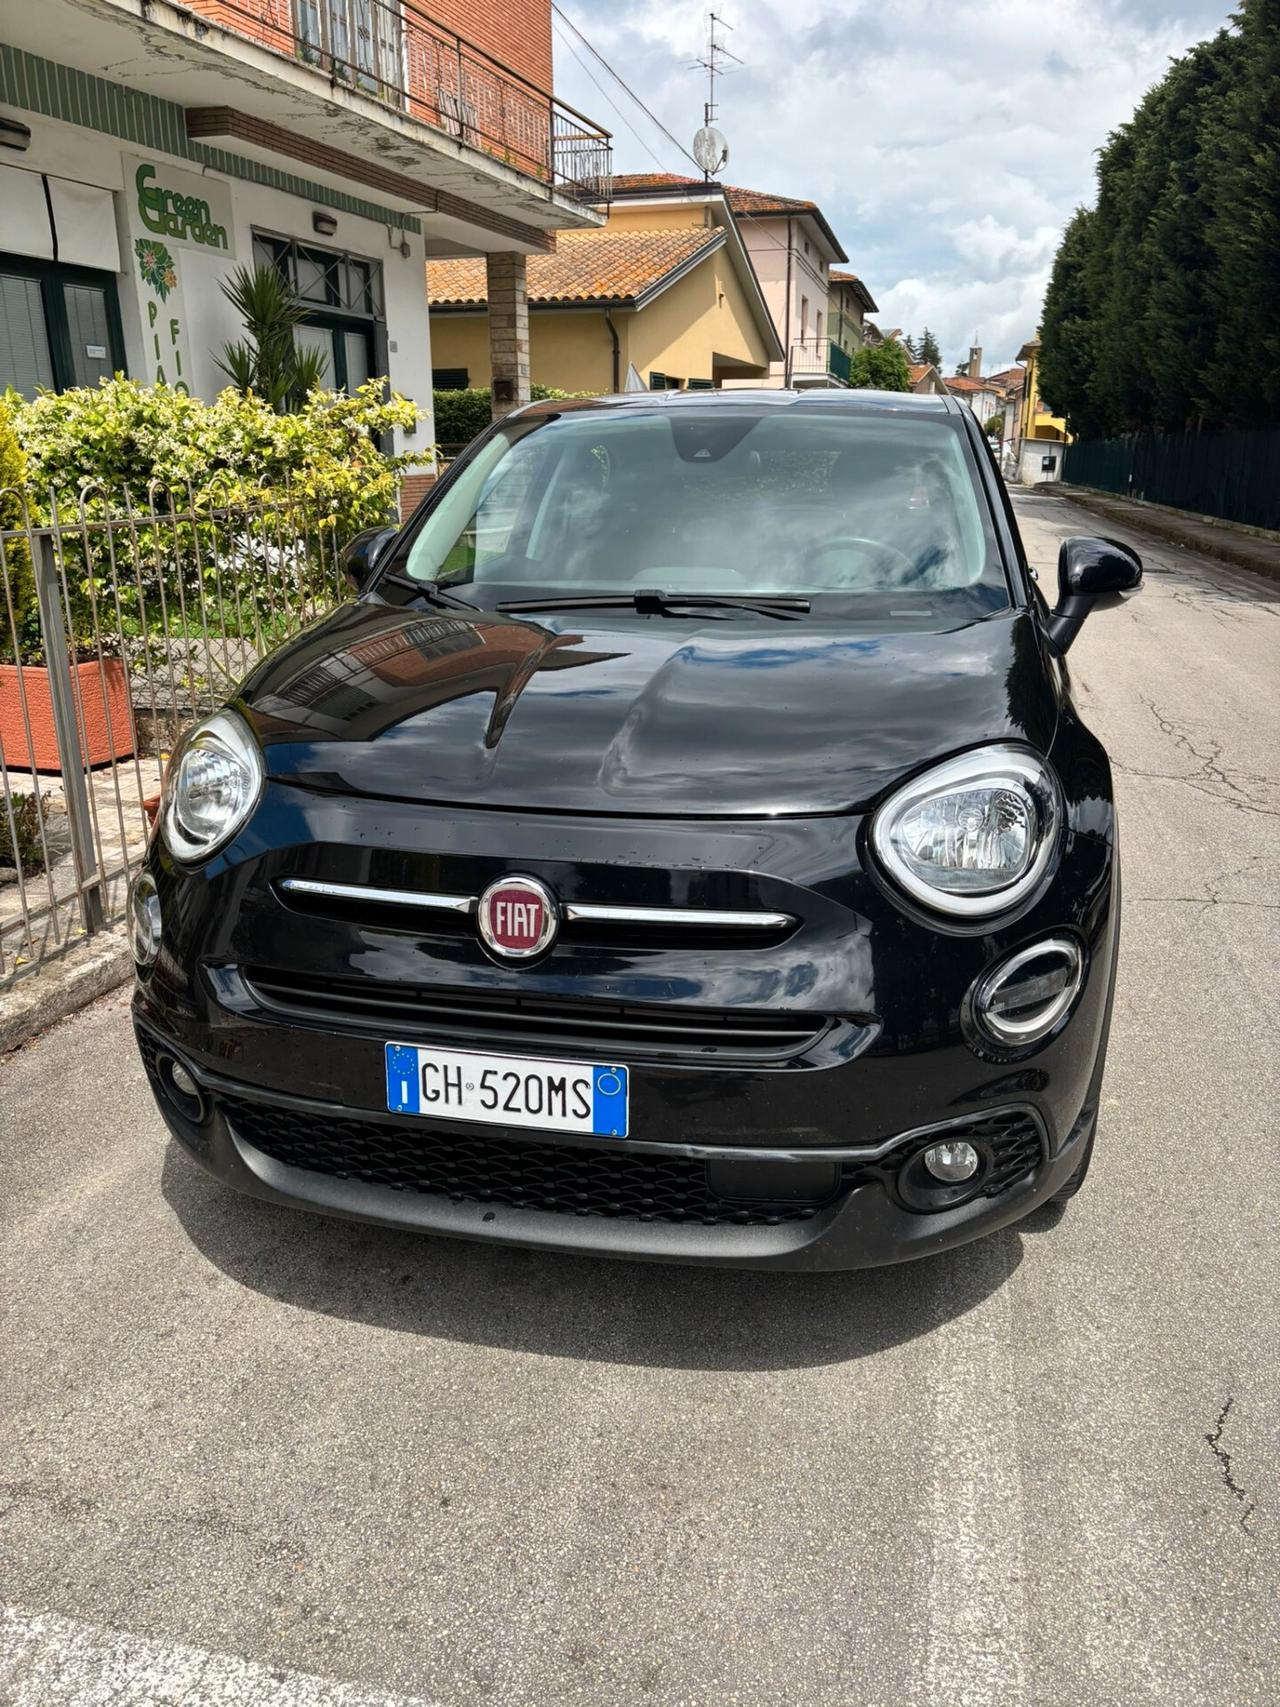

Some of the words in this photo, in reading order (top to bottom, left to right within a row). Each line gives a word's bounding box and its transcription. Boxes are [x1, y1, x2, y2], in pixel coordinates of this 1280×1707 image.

[136, 164, 211, 225] Green
[138, 187, 229, 250] Garden
[496, 901, 540, 938] FIAT
[421, 1062, 463, 1106] GH
[479, 1069, 592, 1120] 520MS
